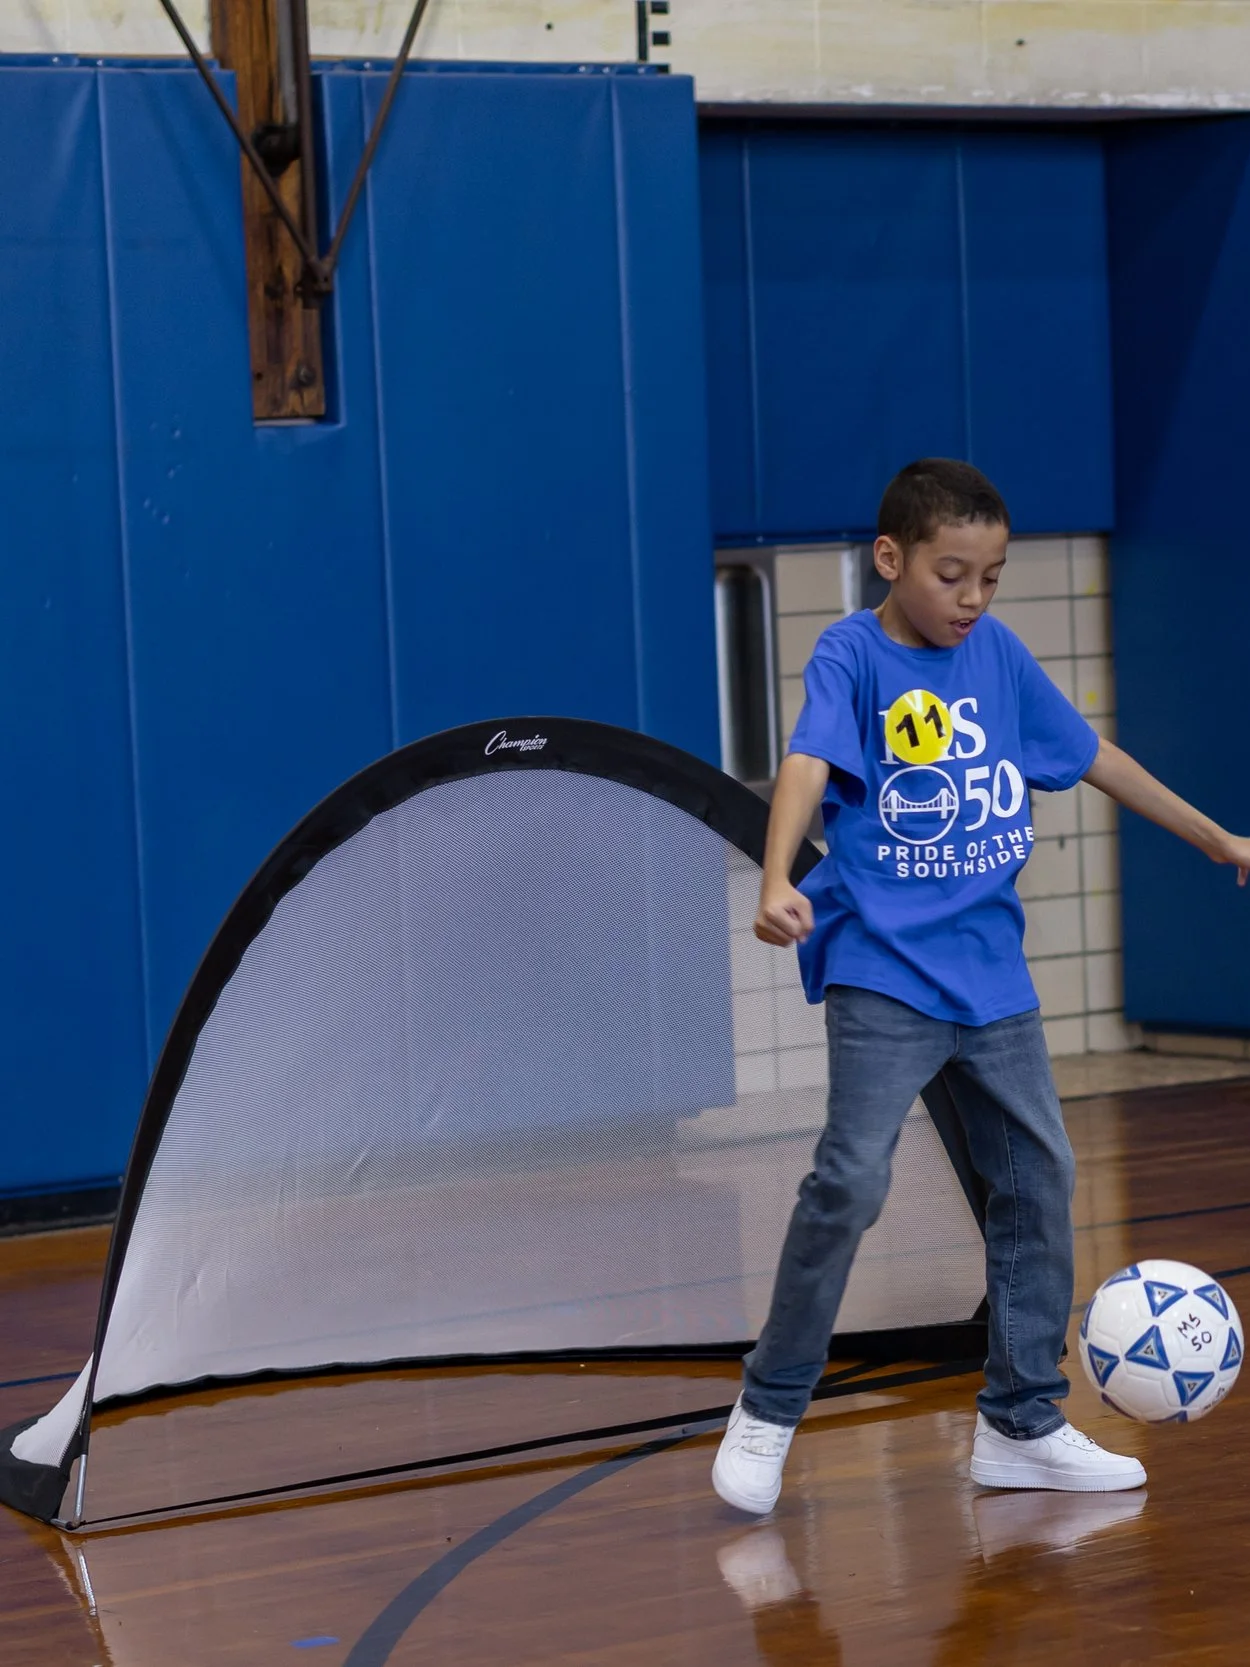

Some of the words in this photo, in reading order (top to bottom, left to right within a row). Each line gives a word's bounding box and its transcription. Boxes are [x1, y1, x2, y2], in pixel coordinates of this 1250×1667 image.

[485, 730, 548, 756] Champion
[878, 697, 986, 765] S
[895, 704, 946, 748] 11
[964, 759, 1025, 832] 50
[878, 845, 955, 861] PRIDE
[966, 840, 987, 858] OF
[992, 826, 1035, 850] THE
[896, 844, 1026, 878] SOUTHSIDE
[1177, 1313, 1201, 1338] MS
[1191, 1331, 1212, 1352] 50
